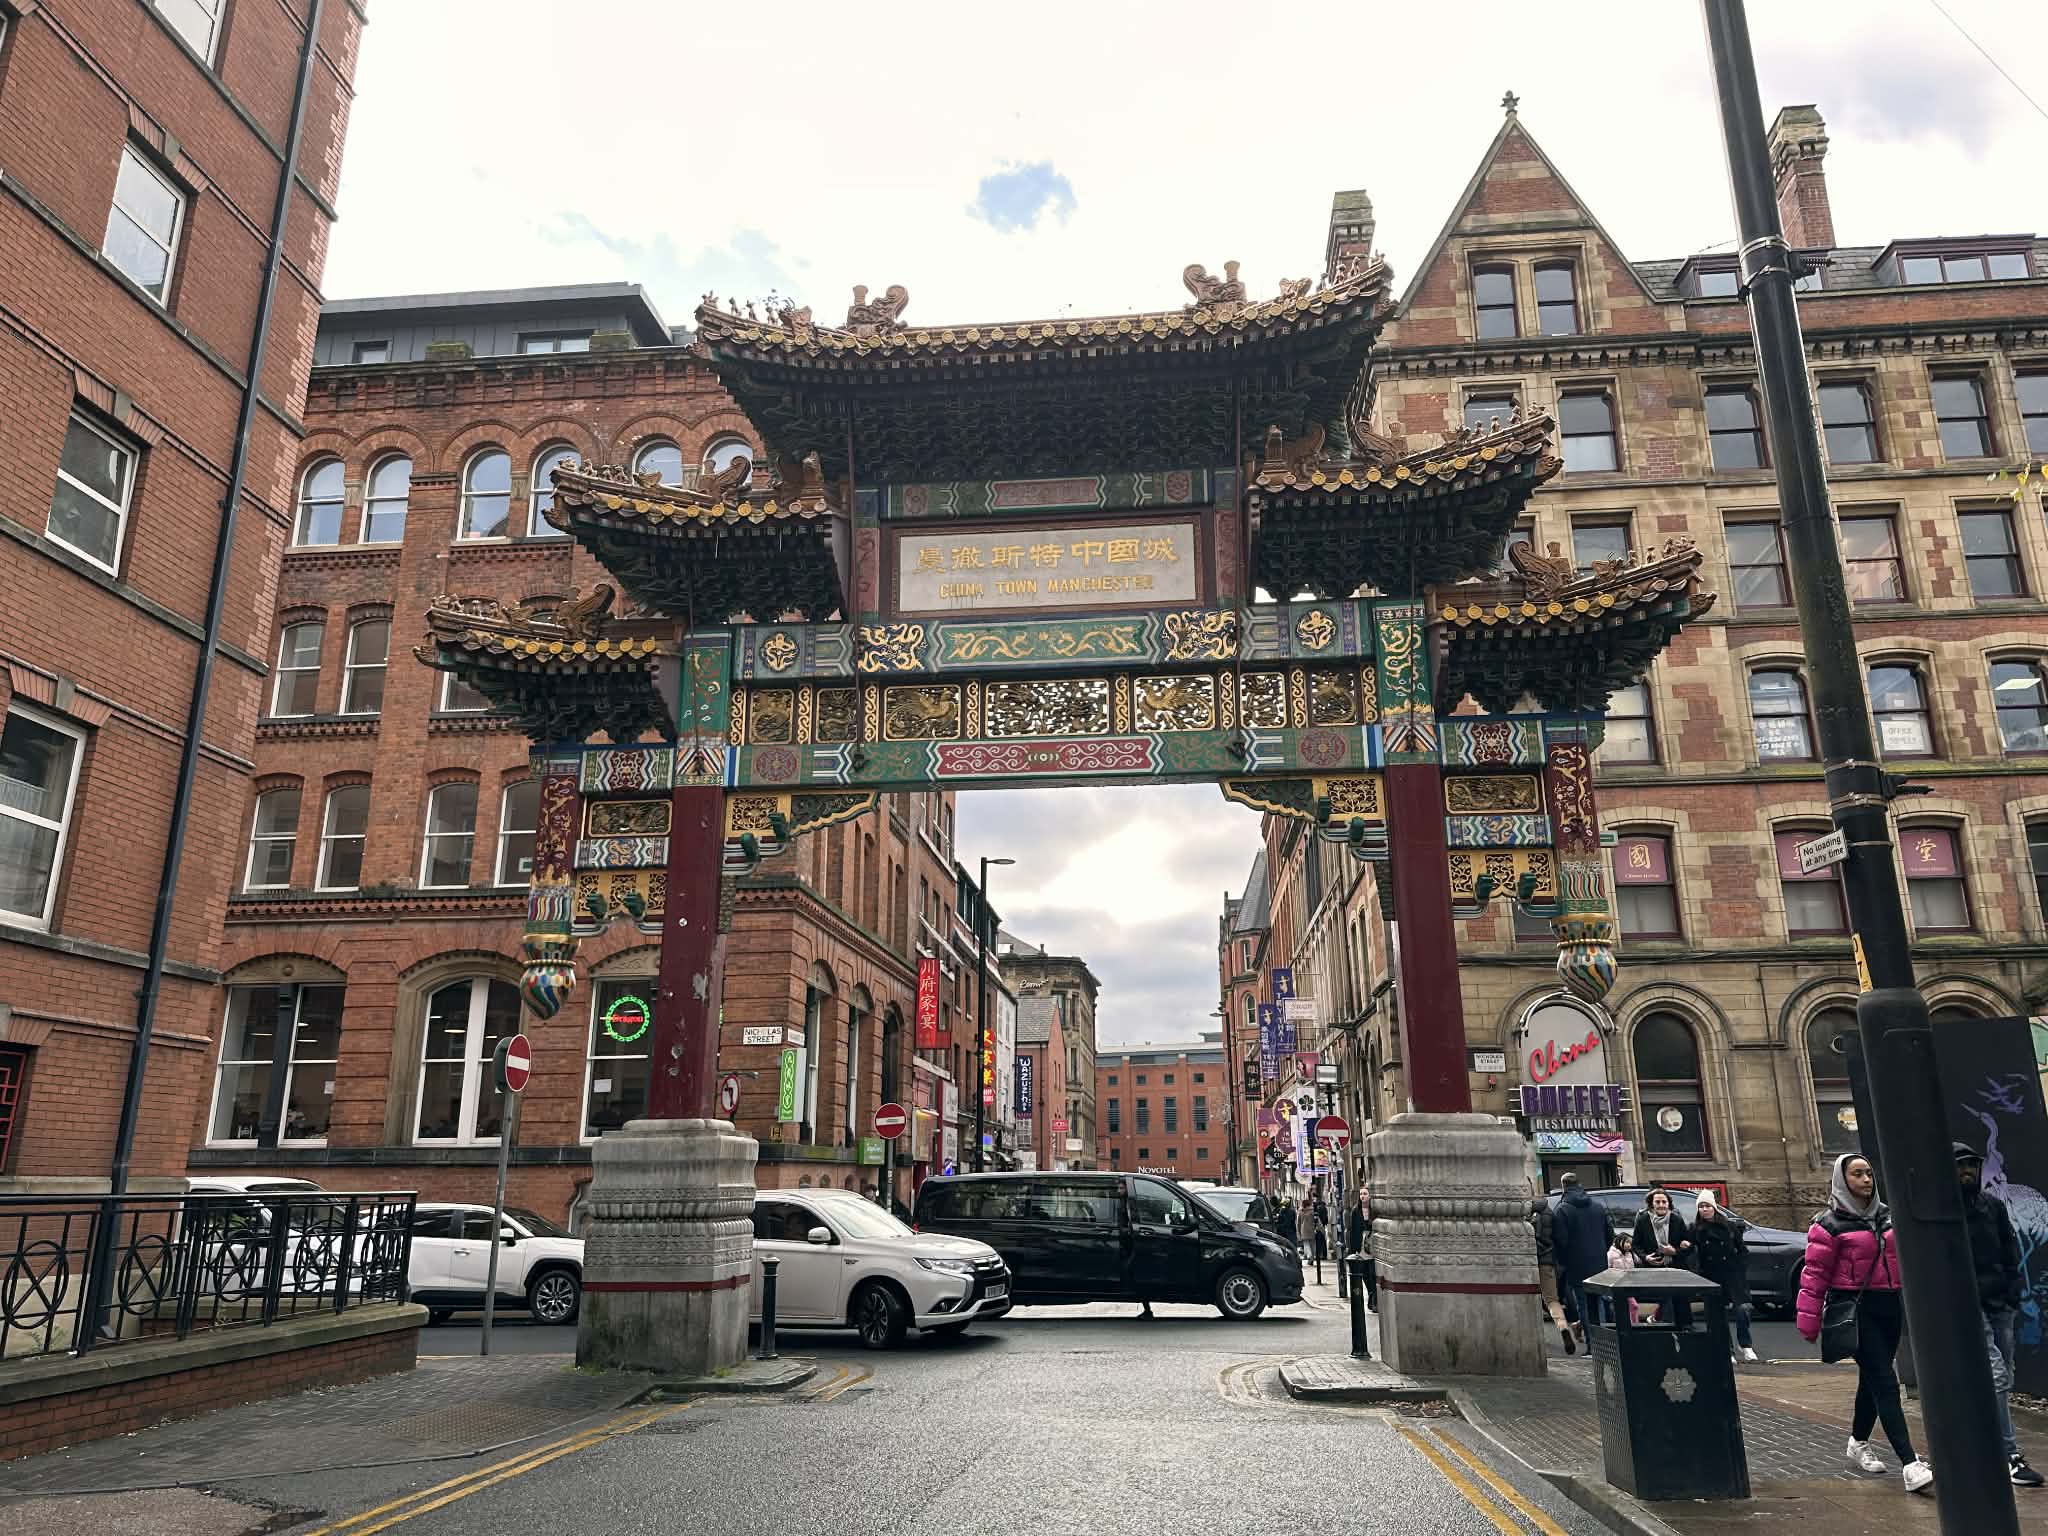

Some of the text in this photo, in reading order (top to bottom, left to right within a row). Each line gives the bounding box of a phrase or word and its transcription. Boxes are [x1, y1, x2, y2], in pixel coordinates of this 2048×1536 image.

[940, 583, 984, 599] CHINA
[995, 578, 1037, 594] TOWN
[1803, 847, 1813, 856] No
[1815, 836, 1841, 852] loading
[1806, 847, 1844, 867] at any time
[920, 960, 937, 1030] 川府家宴
[744, 1027, 781, 1036] NICLAS
[747, 1035, 775, 1043] STREET
[1530, 1031, 1600, 1083] China
[1520, 1085, 1620, 1116] BUFFET
[1536, 1118, 1614, 1130] RESTAURANT
[1138, 1166, 1177, 1174] NOVOTEL
